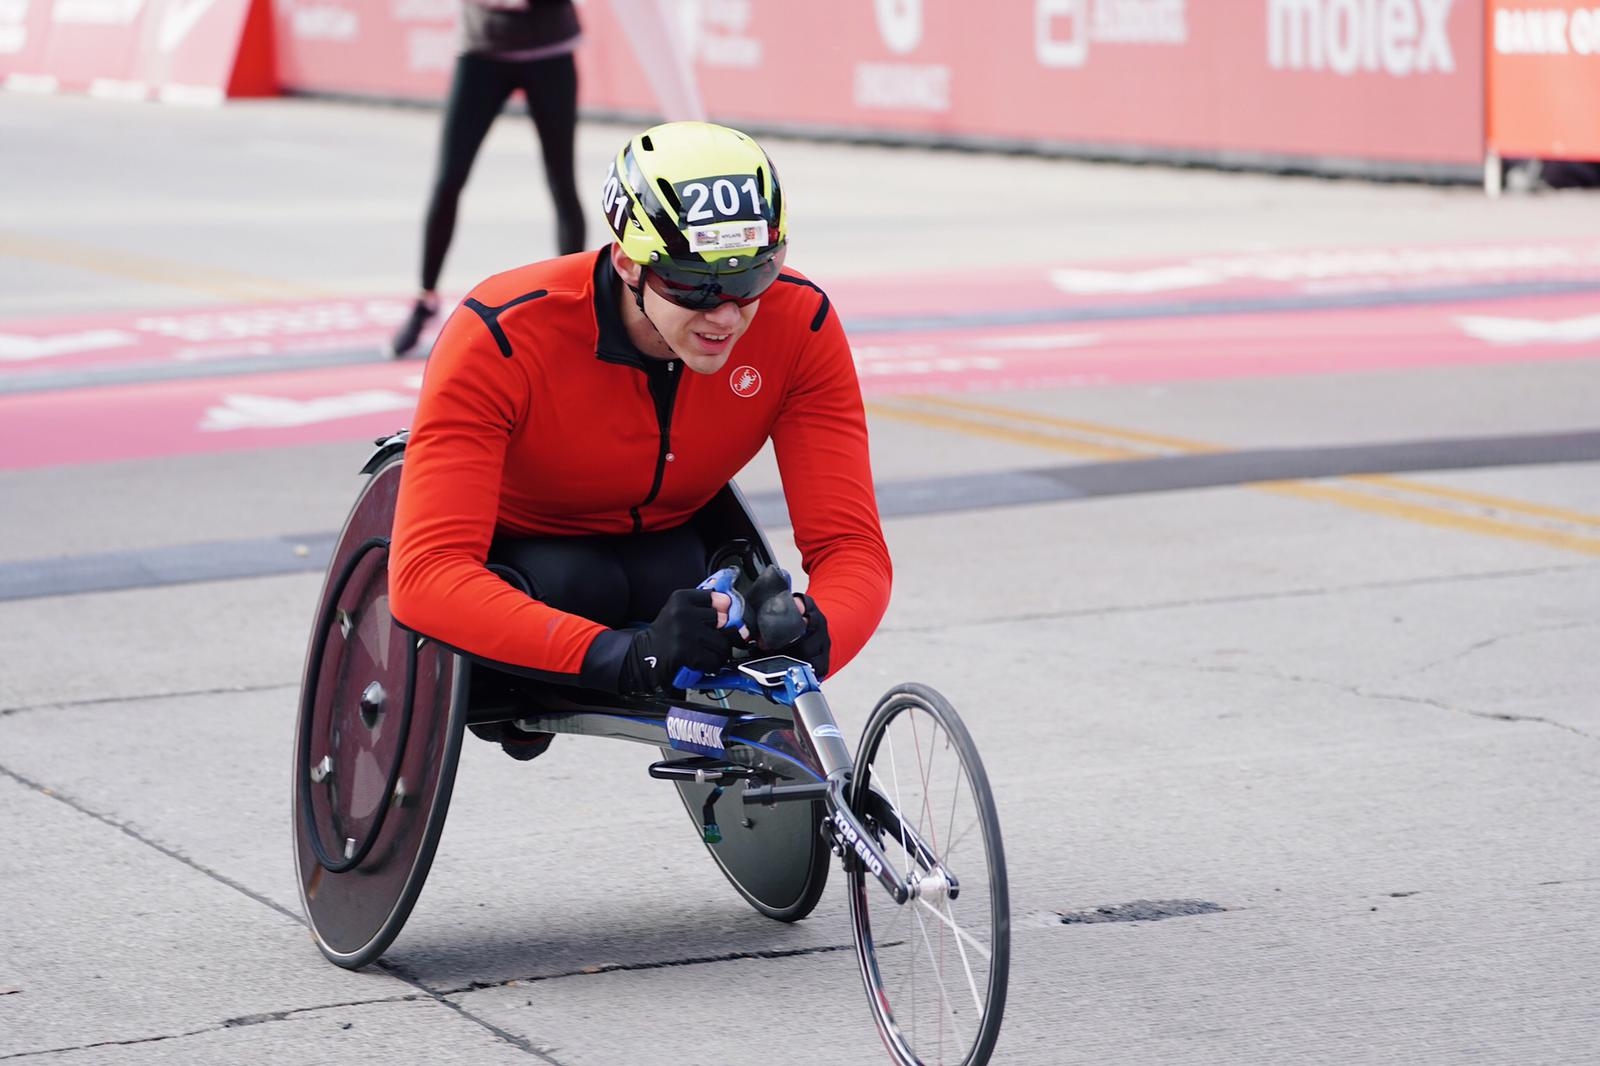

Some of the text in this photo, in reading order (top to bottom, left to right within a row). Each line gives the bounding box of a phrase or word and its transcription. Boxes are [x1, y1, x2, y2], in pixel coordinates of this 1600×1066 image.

[1265, 0, 1455, 76] molex
[682, 178, 762, 222] 201
[666, 716, 725, 750] ROMANCHUK
[834, 810, 883, 877] TOP END
